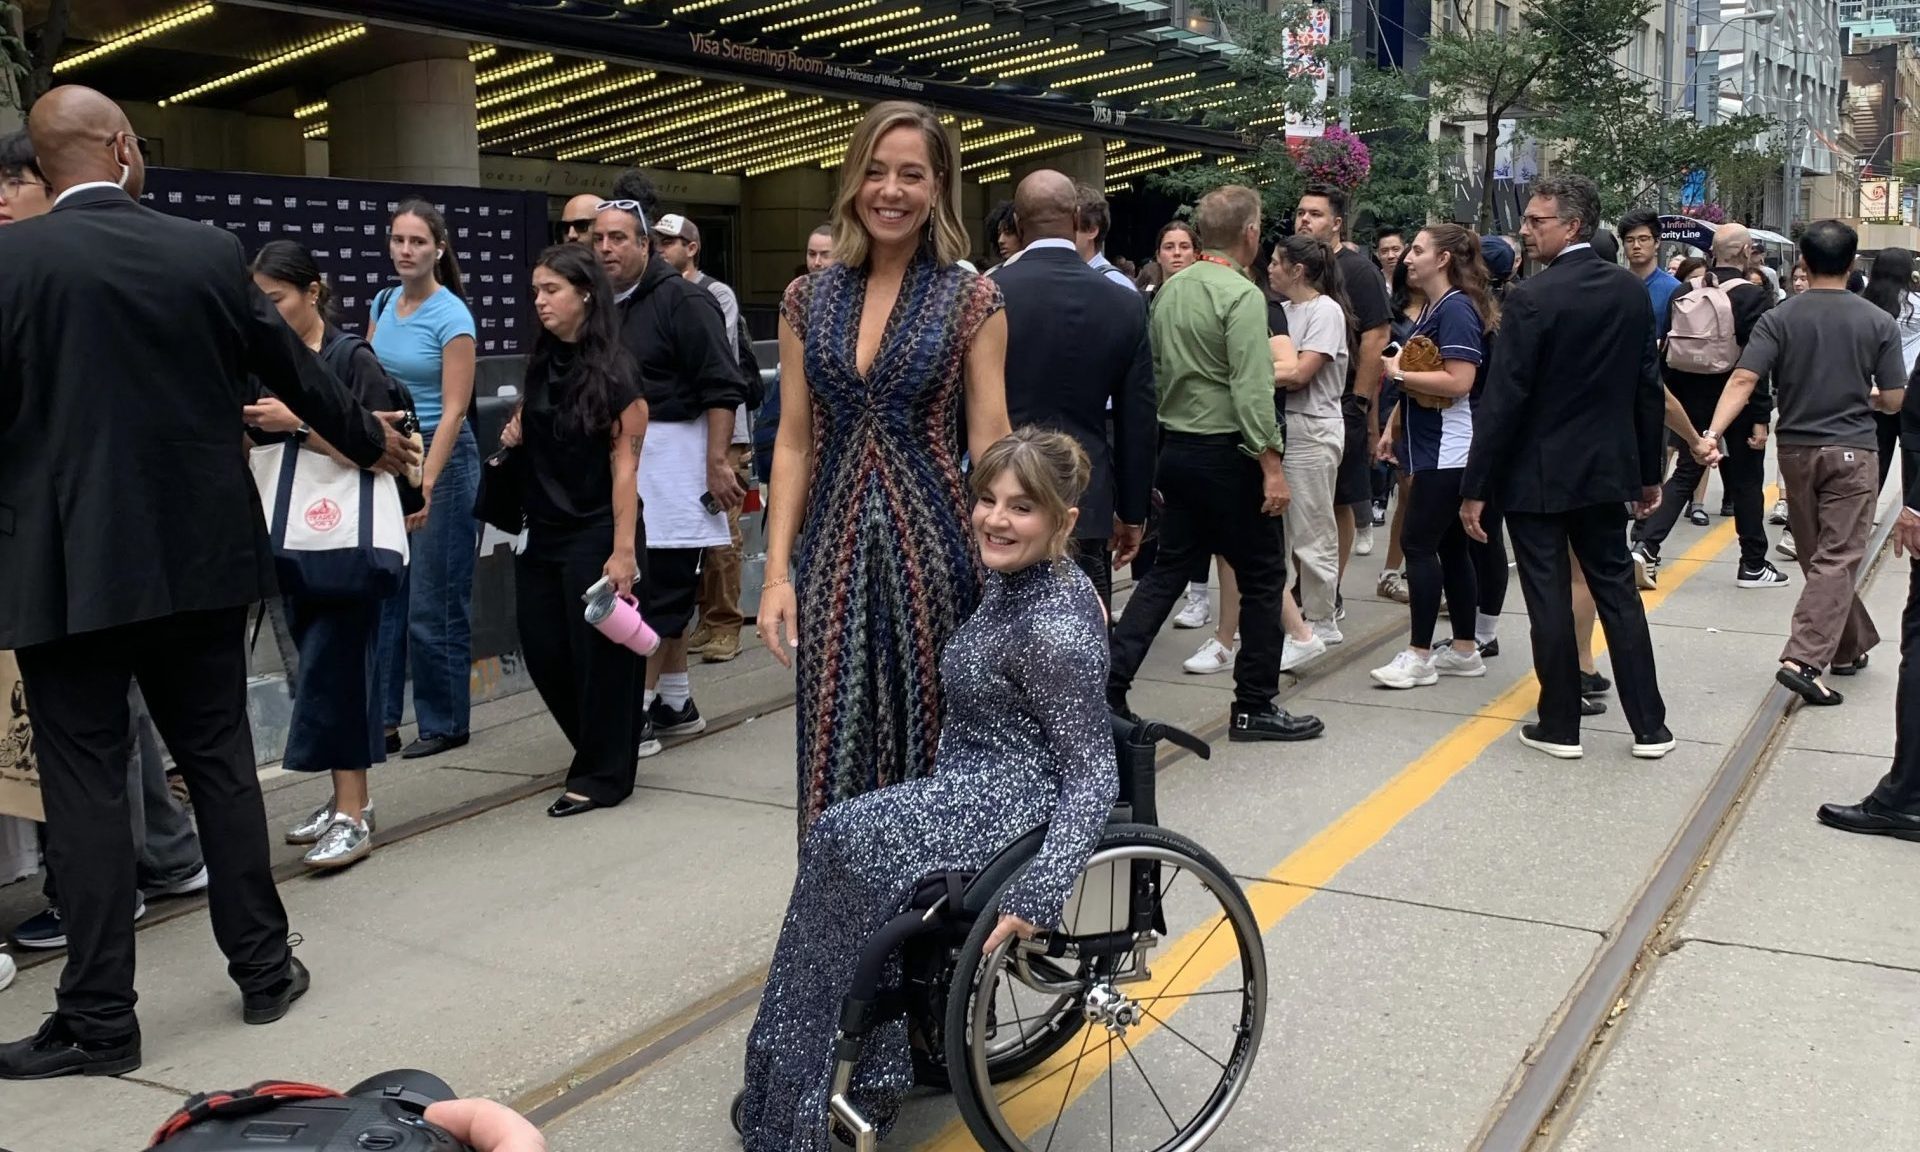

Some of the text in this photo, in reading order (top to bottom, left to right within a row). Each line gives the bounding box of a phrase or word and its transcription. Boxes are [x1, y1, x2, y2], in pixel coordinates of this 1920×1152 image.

[689, 31, 823, 74] Visa Screening Room
[824, 64, 924, 91] At the Princess of Wales Theatre
[1091, 105, 1111, 124] VISA
[1666, 220, 1696, 229] Infinite
[1661, 230, 1701, 240] ority Line
